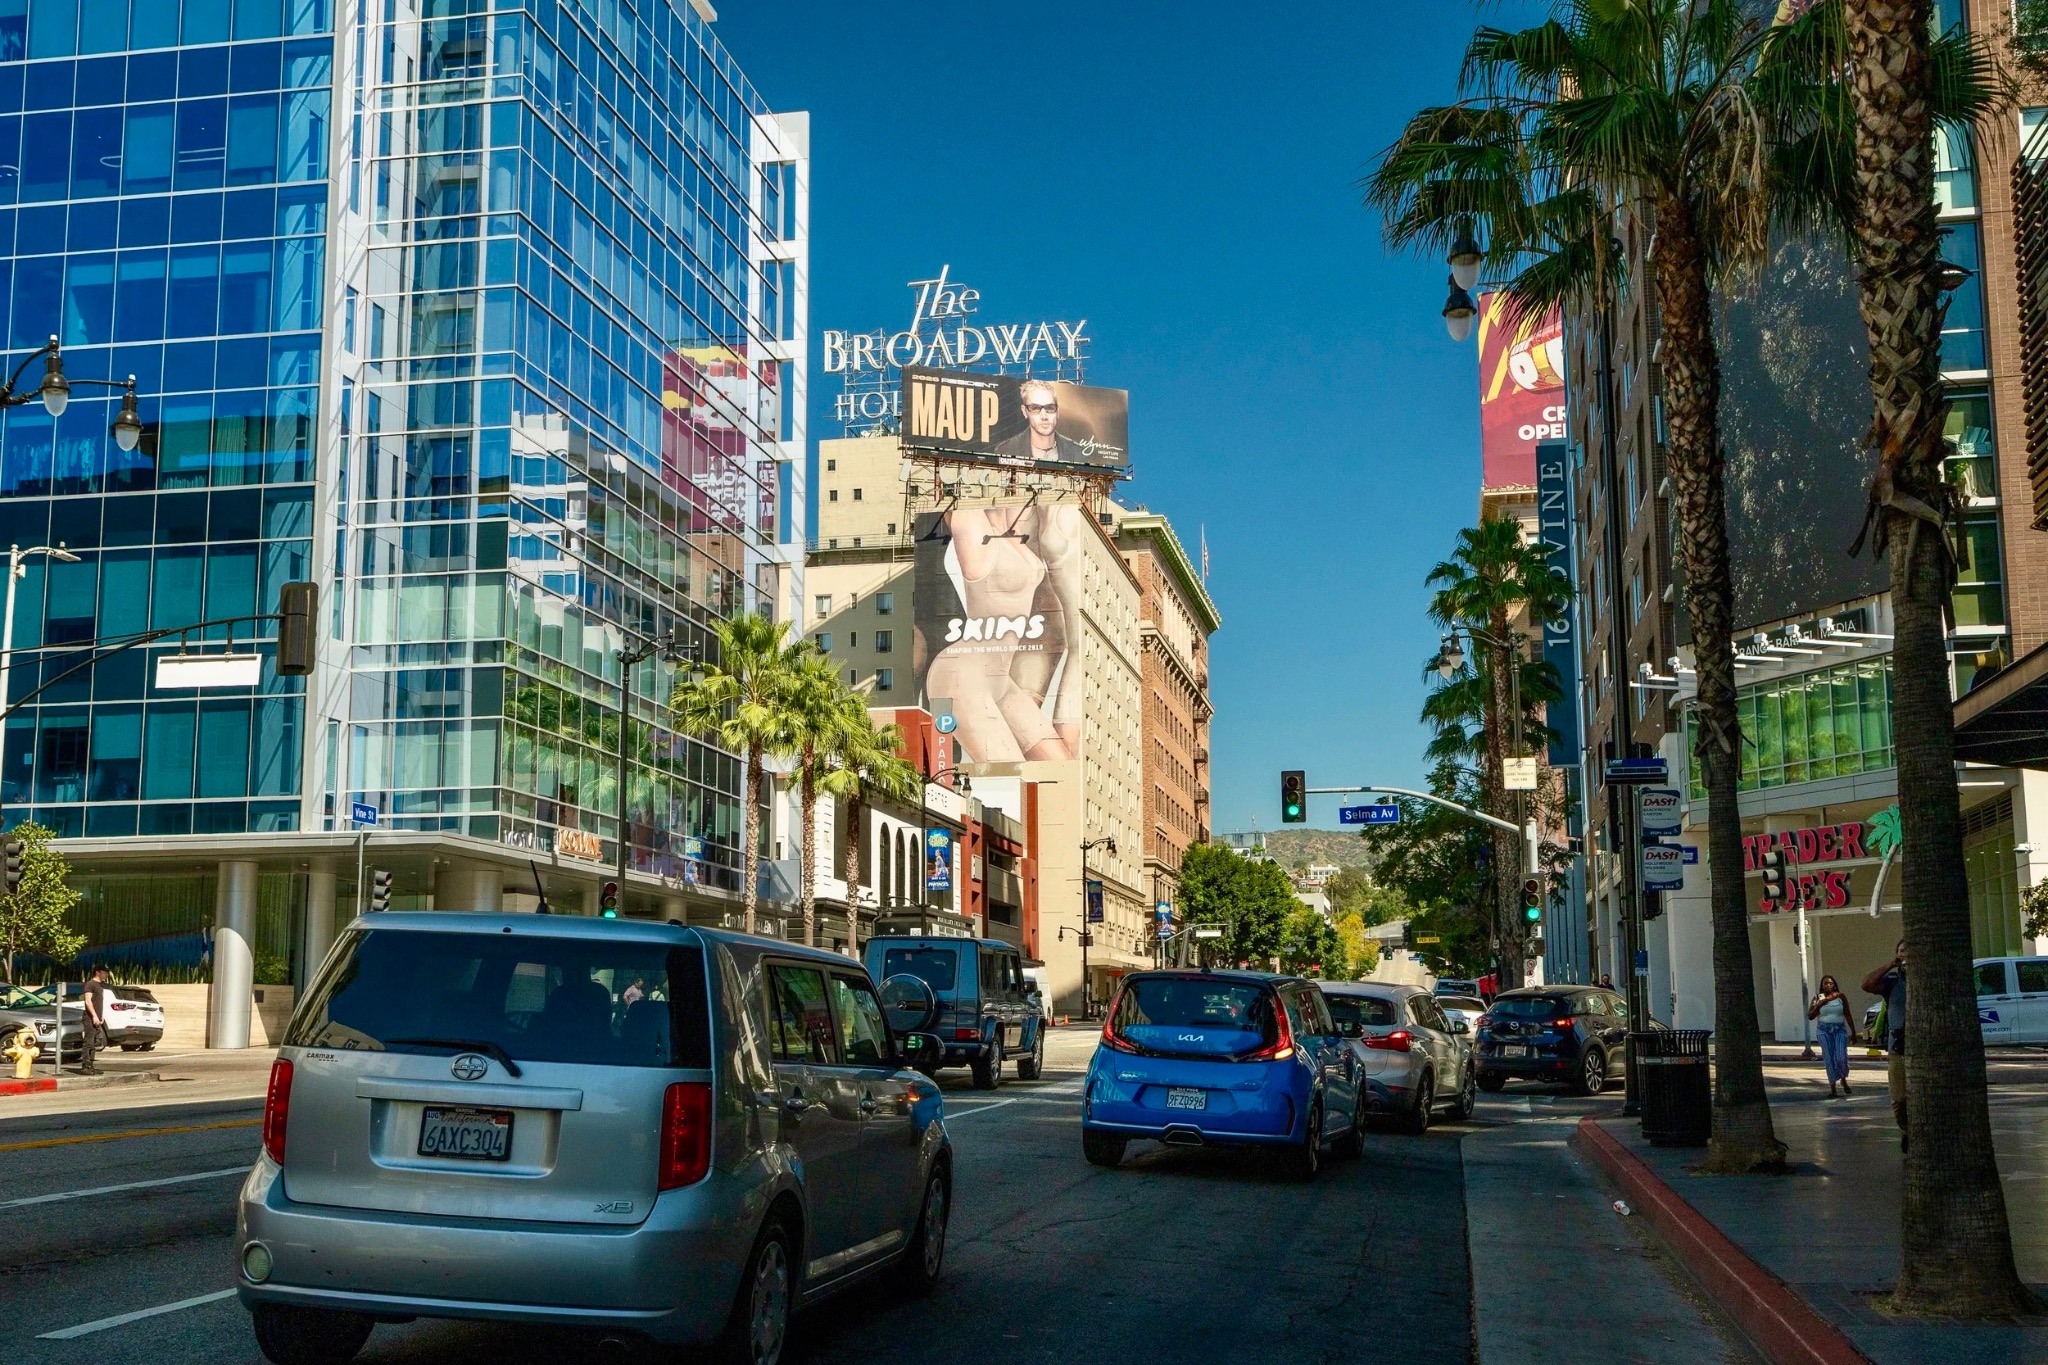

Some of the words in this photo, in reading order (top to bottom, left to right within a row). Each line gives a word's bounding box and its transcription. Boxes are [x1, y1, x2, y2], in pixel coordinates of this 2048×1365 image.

[906, 264, 980, 350] The
[823, 319, 1087, 373] BROADWAY
[912, 382, 975, 442] MAU
[981, 389, 999, 443] P
[1518, 422, 1567, 440] OPE
[945, 615, 1045, 643] SKIMS
[974, 646, 986, 654] THE
[987, 645, 1009, 653] WORLD
[1010, 644, 1027, 652] SINCE
[941, 715, 953, 731] P
[1643, 798, 1677, 806] DASH
[355, 807, 367, 819] Vine
[367, 810, 374, 820] St
[1345, 810, 1377, 820] Selma
[1381, 809, 1393, 818] Av
[1742, 821, 1865, 870] TRADER
[1645, 852, 1679, 860] DASH
[1178, 1034, 1204, 1042] KIA
[1169, 1094, 1204, 1107] 9FZD996
[427, 1111, 439, 1119] AUG
[425, 1125, 503, 1152] 6AXC304
[593, 1200, 633, 1214] xB
